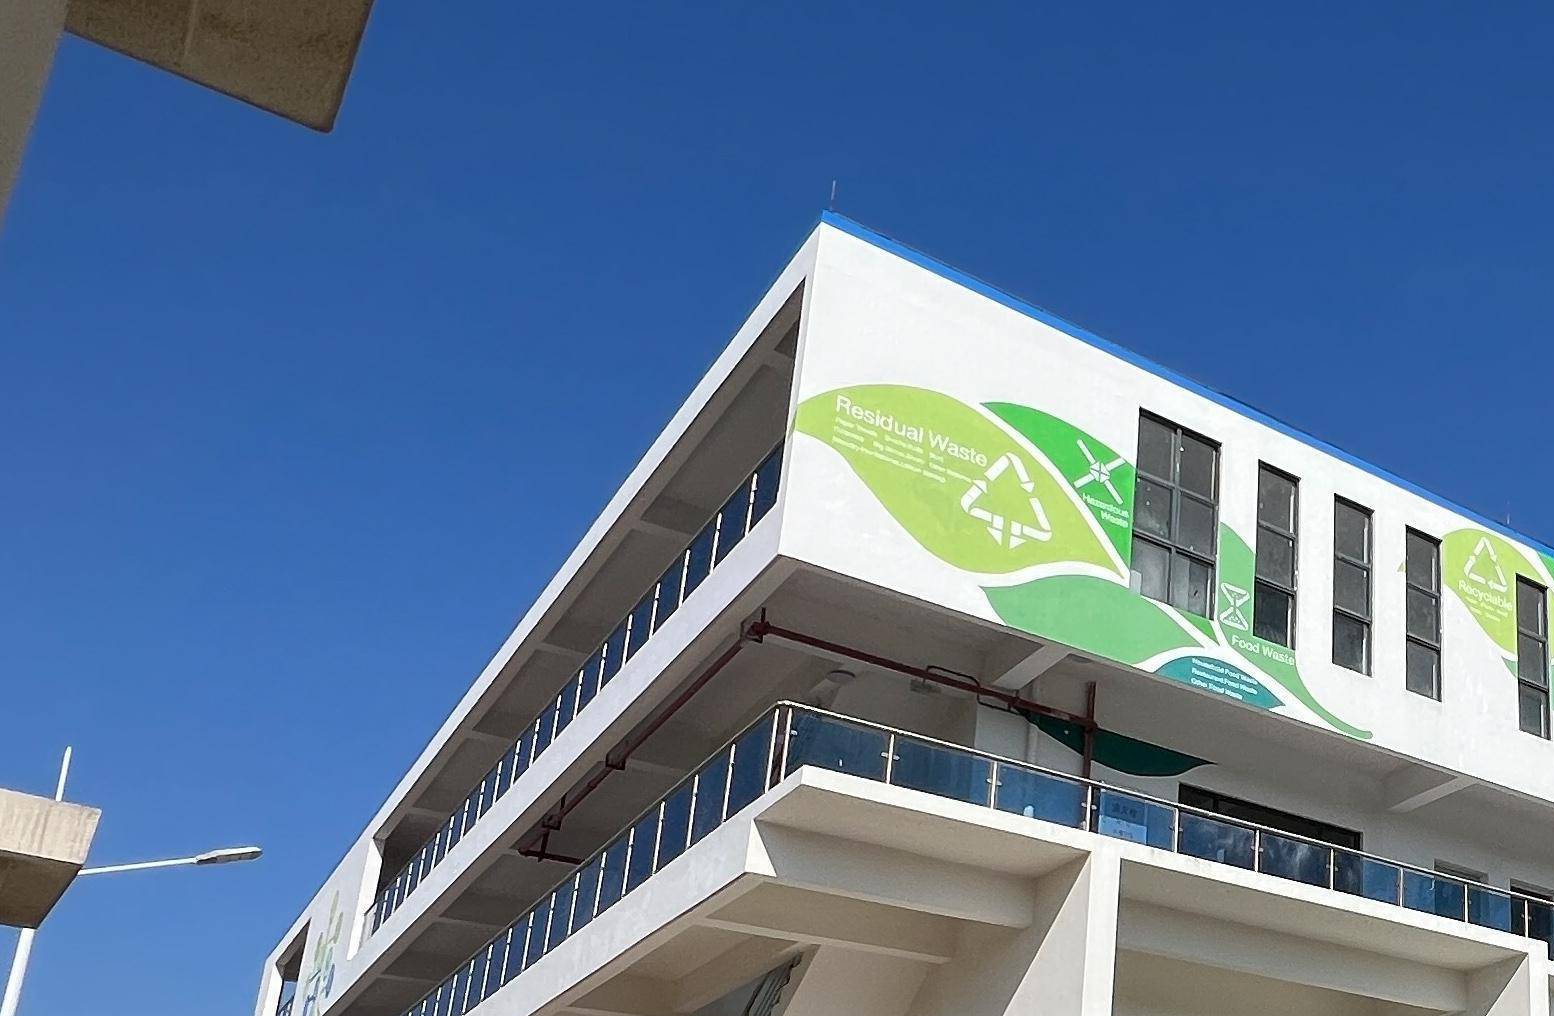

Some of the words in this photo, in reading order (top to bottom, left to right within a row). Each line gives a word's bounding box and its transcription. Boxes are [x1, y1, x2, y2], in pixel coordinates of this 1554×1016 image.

[835, 394, 924, 444] Residual
[928, 429, 988, 468] Waste
[1231, 635, 1260, 654] Food
[1261, 645, 1295, 666] Waste
